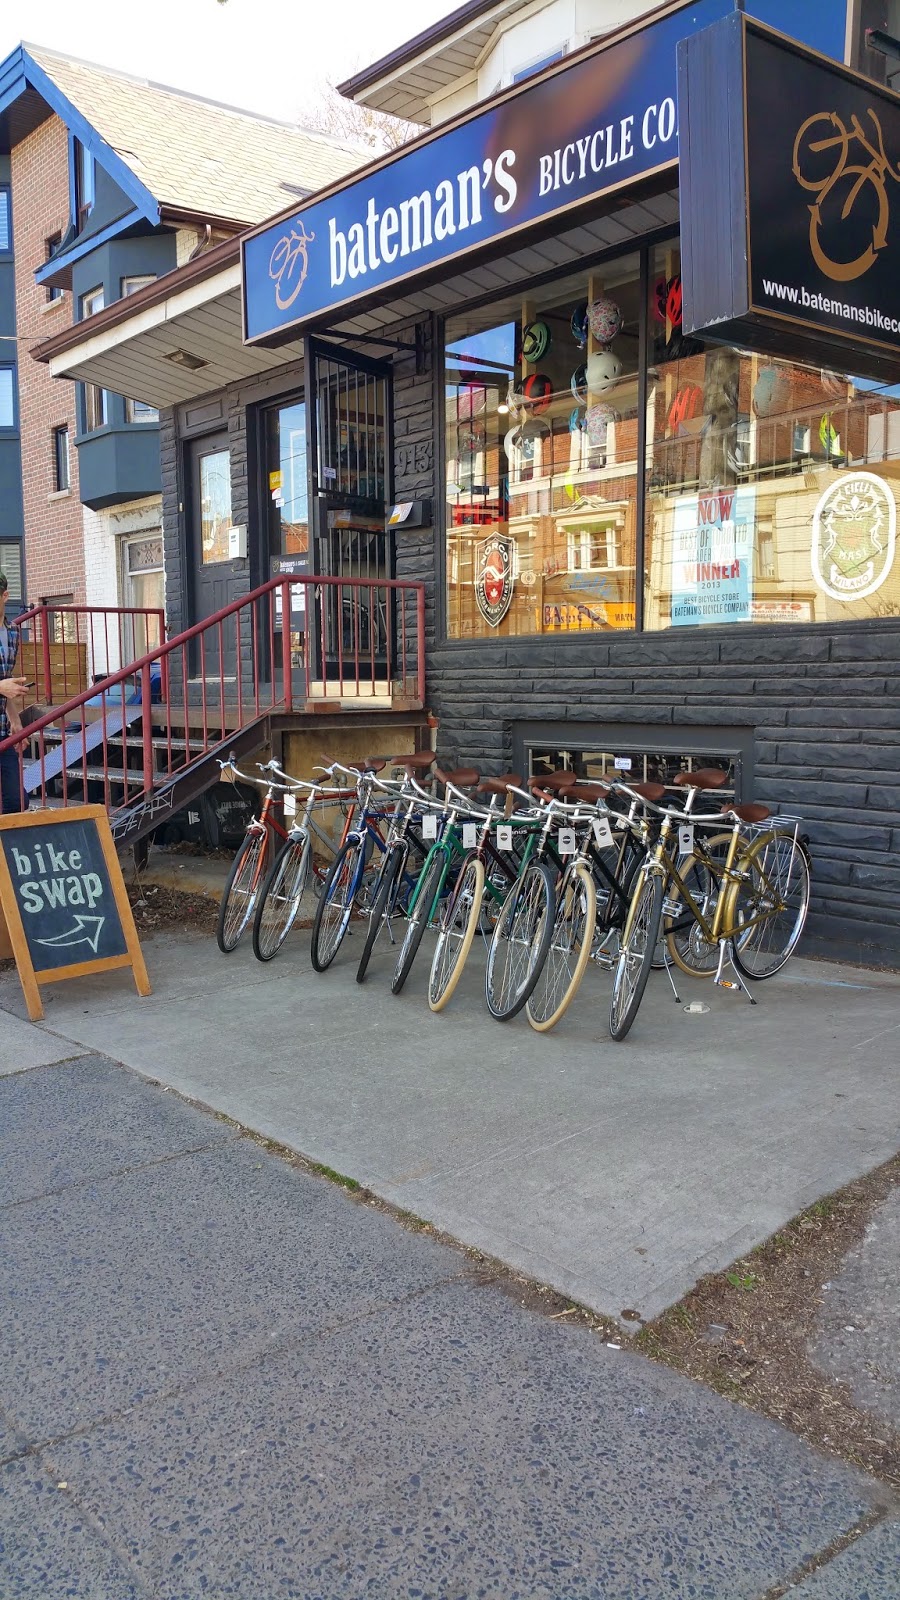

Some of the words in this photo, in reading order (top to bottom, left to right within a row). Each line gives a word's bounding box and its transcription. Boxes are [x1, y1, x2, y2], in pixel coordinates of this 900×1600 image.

[328, 149, 518, 289] bateman's
[538, 115, 634, 197] BICYCLE
[641, 97, 679, 150] CO
[698, 495, 734, 526] NOW
[700, 528, 709, 548] OF
[480, 542, 509, 566] NORCO
[683, 559, 740, 583] WINNER
[834, 573, 869, 588] MILANO
[701, 581, 721, 590] 2013
[674, 604, 702, 617] BATEMAN'S
[702, 602, 723, 615] BICYCLE
[724, 601, 749, 614] COMPANY
[683, 595, 698, 605] BEST
[698, 593, 720, 604] BICYCLE
[721, 592, 740, 602] STORE
[11, 844, 82, 876] bike
[19, 873, 104, 914] swap
